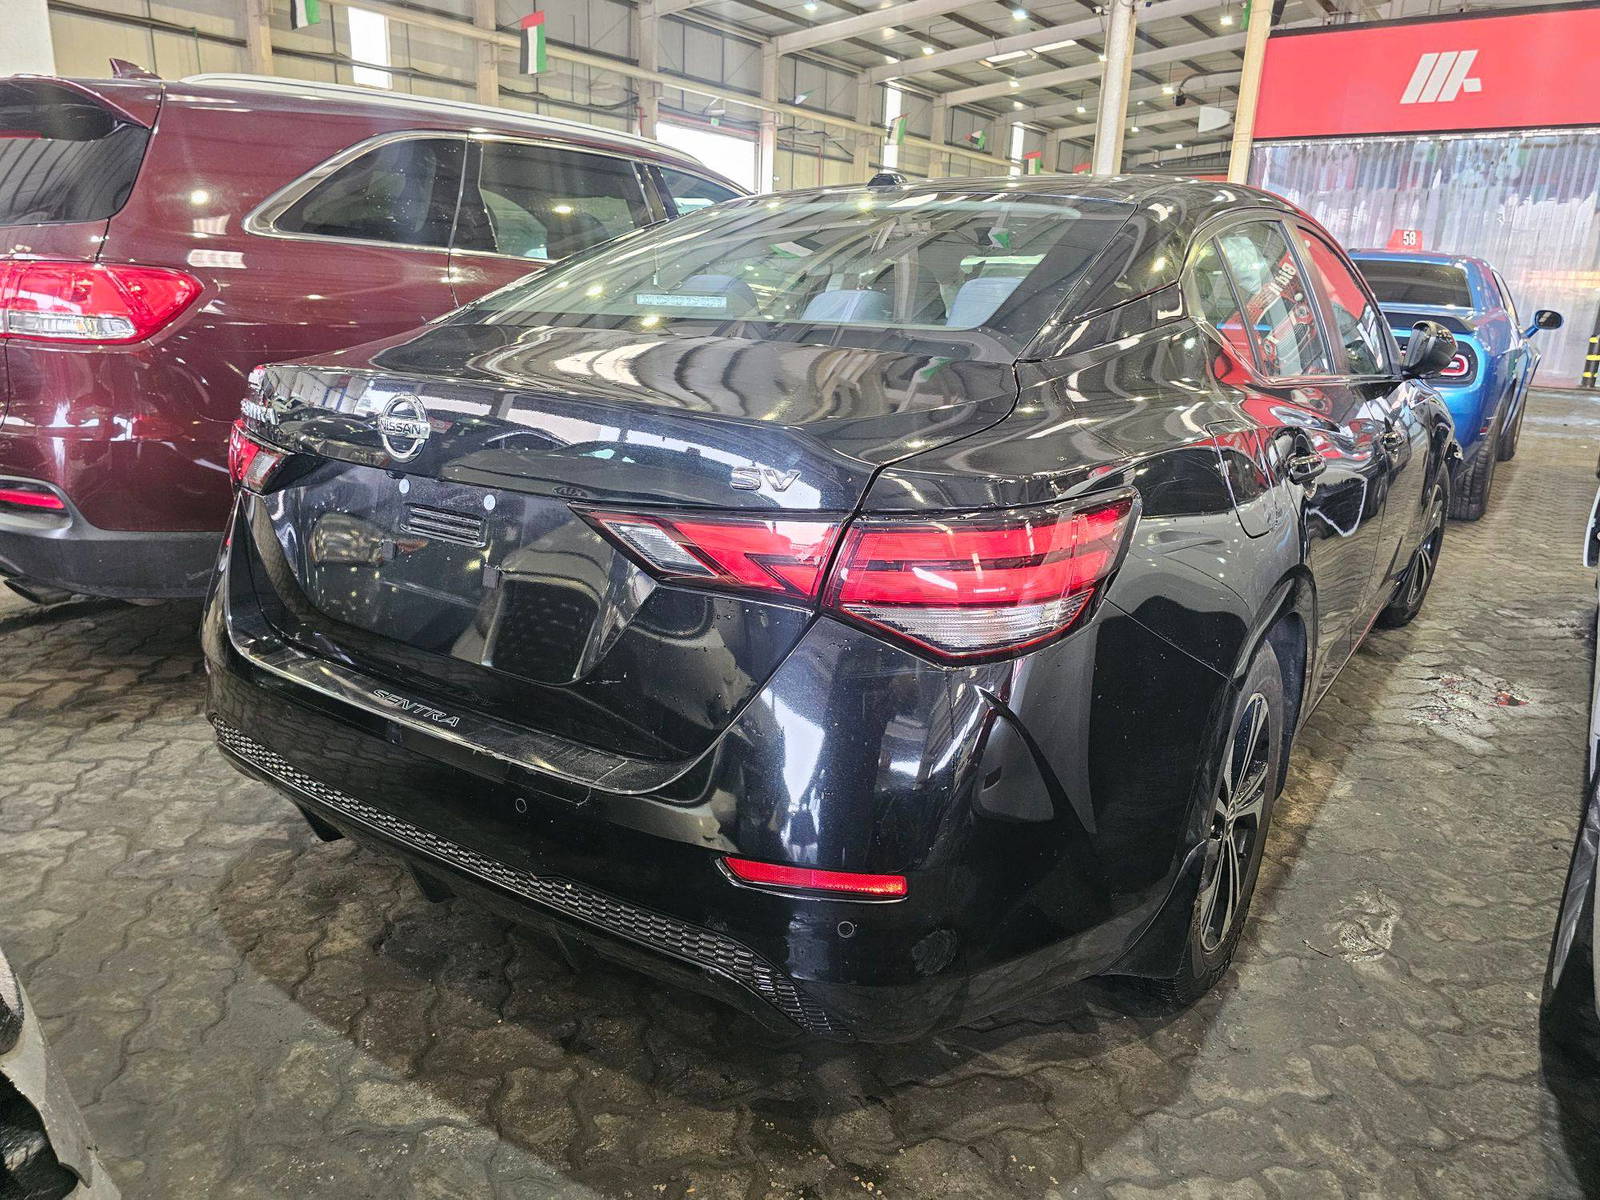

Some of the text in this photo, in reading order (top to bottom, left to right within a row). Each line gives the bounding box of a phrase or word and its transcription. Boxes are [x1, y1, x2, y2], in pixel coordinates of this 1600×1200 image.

[1402, 231, 1417, 246] 58
[380, 419, 421, 435] NISSAN
[729, 467, 801, 492] SV
[373, 689, 460, 727] SENTRA
